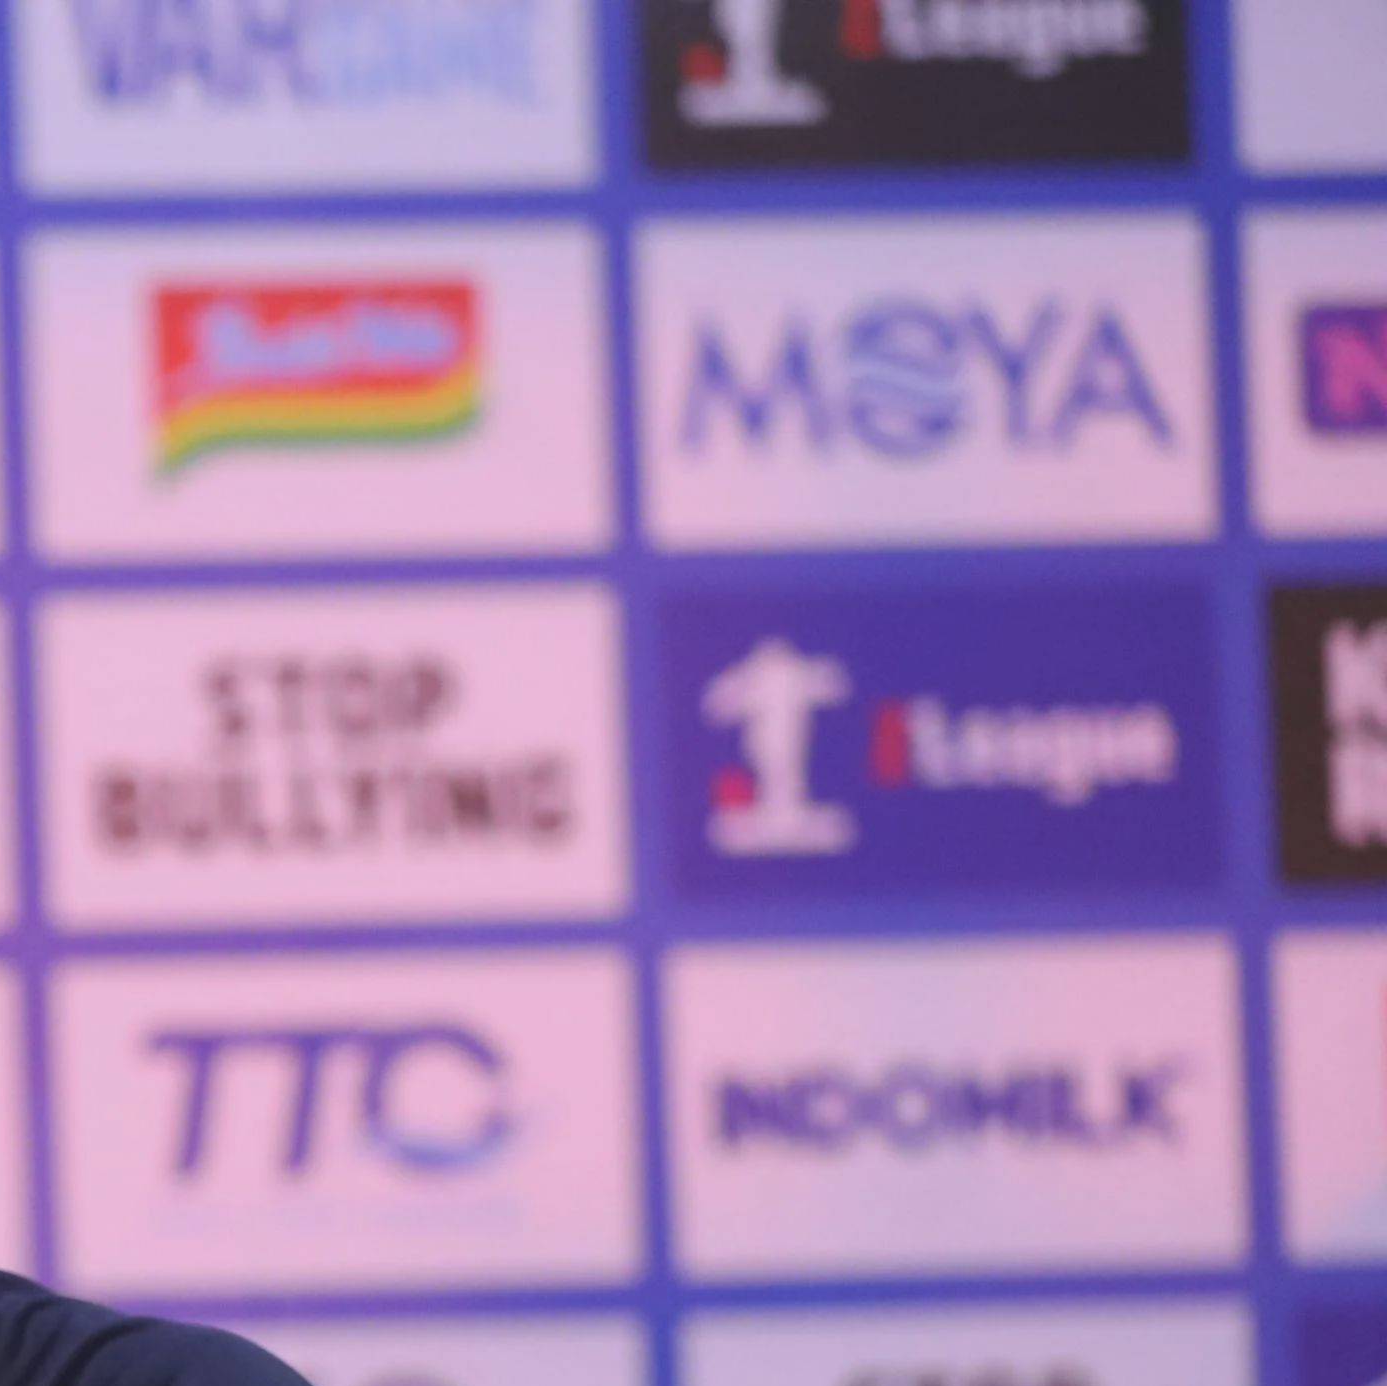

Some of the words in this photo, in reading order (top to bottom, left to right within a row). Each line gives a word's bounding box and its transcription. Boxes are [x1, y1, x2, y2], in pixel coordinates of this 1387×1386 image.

[677, 298, 1175, 458] MOYA
[205, 652, 455, 738] STOP
[95, 755, 572, 852] BULLYING
[147, 1024, 515, 1178] TTC
